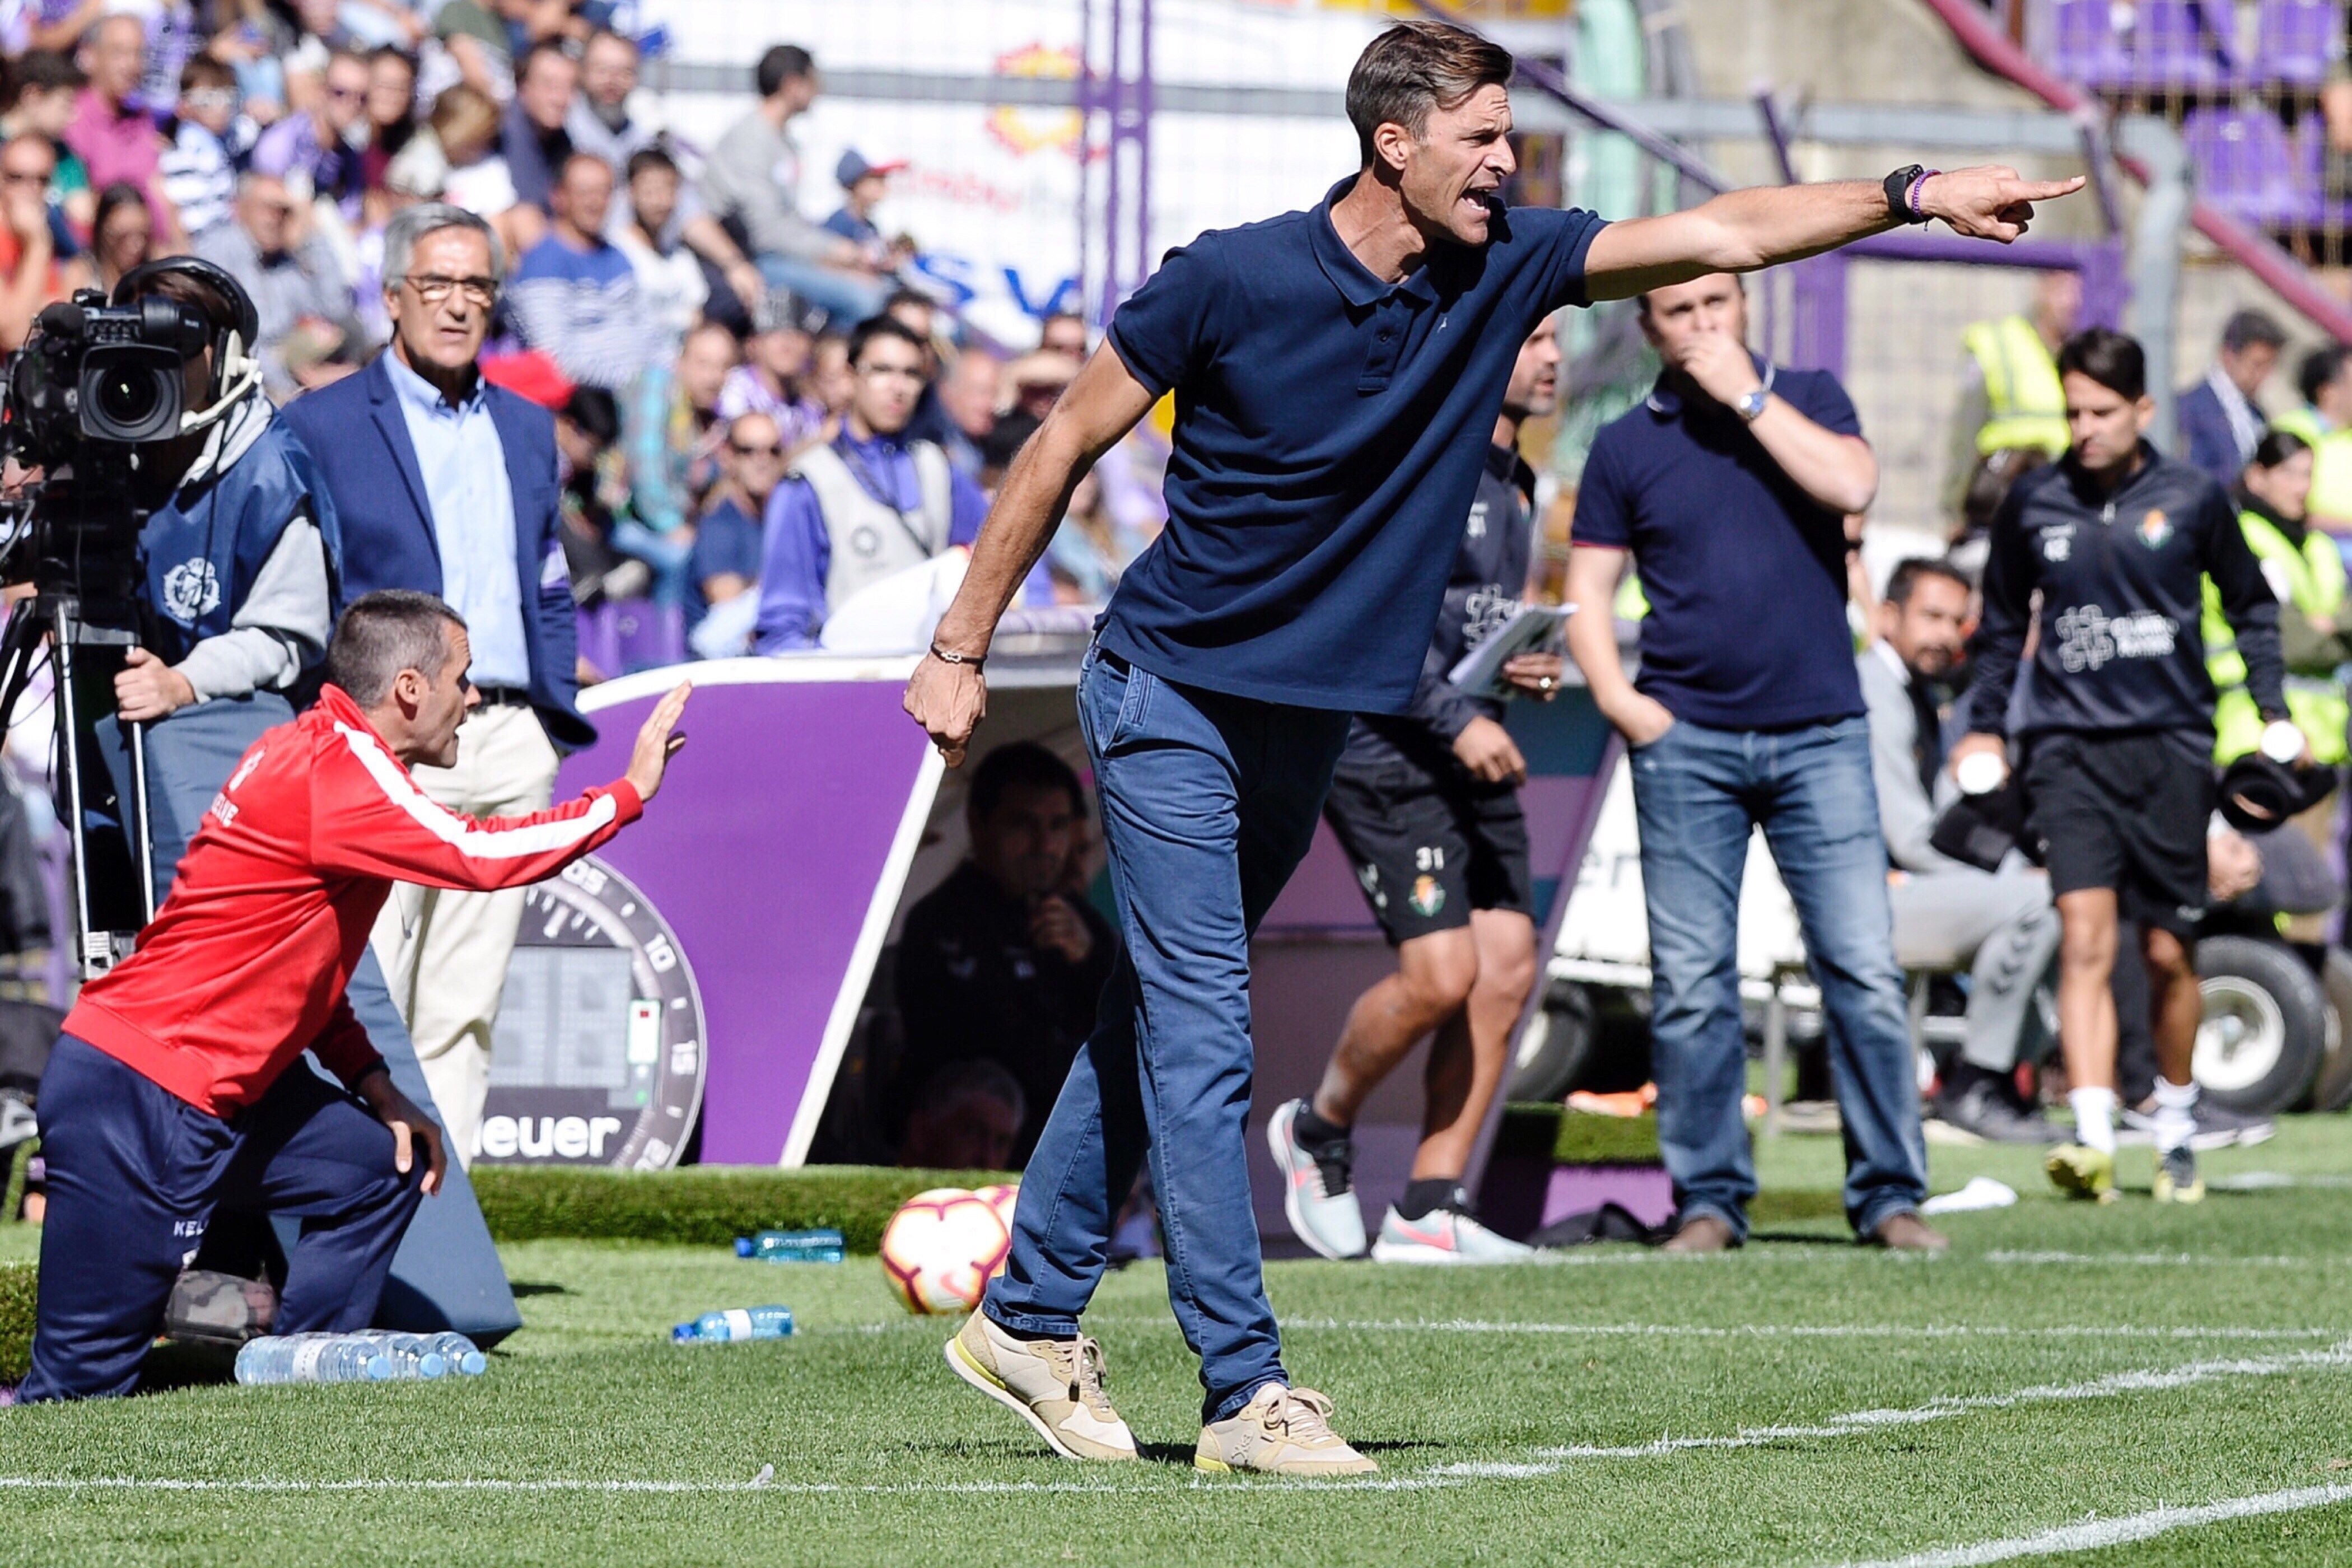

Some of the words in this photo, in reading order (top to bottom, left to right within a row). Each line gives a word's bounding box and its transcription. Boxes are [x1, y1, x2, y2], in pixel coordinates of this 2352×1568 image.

[1415, 846, 1444, 871] 31
[561, 859, 608, 895] 05
[644, 933, 676, 972] 10
[671, 1040, 697, 1075] 15
